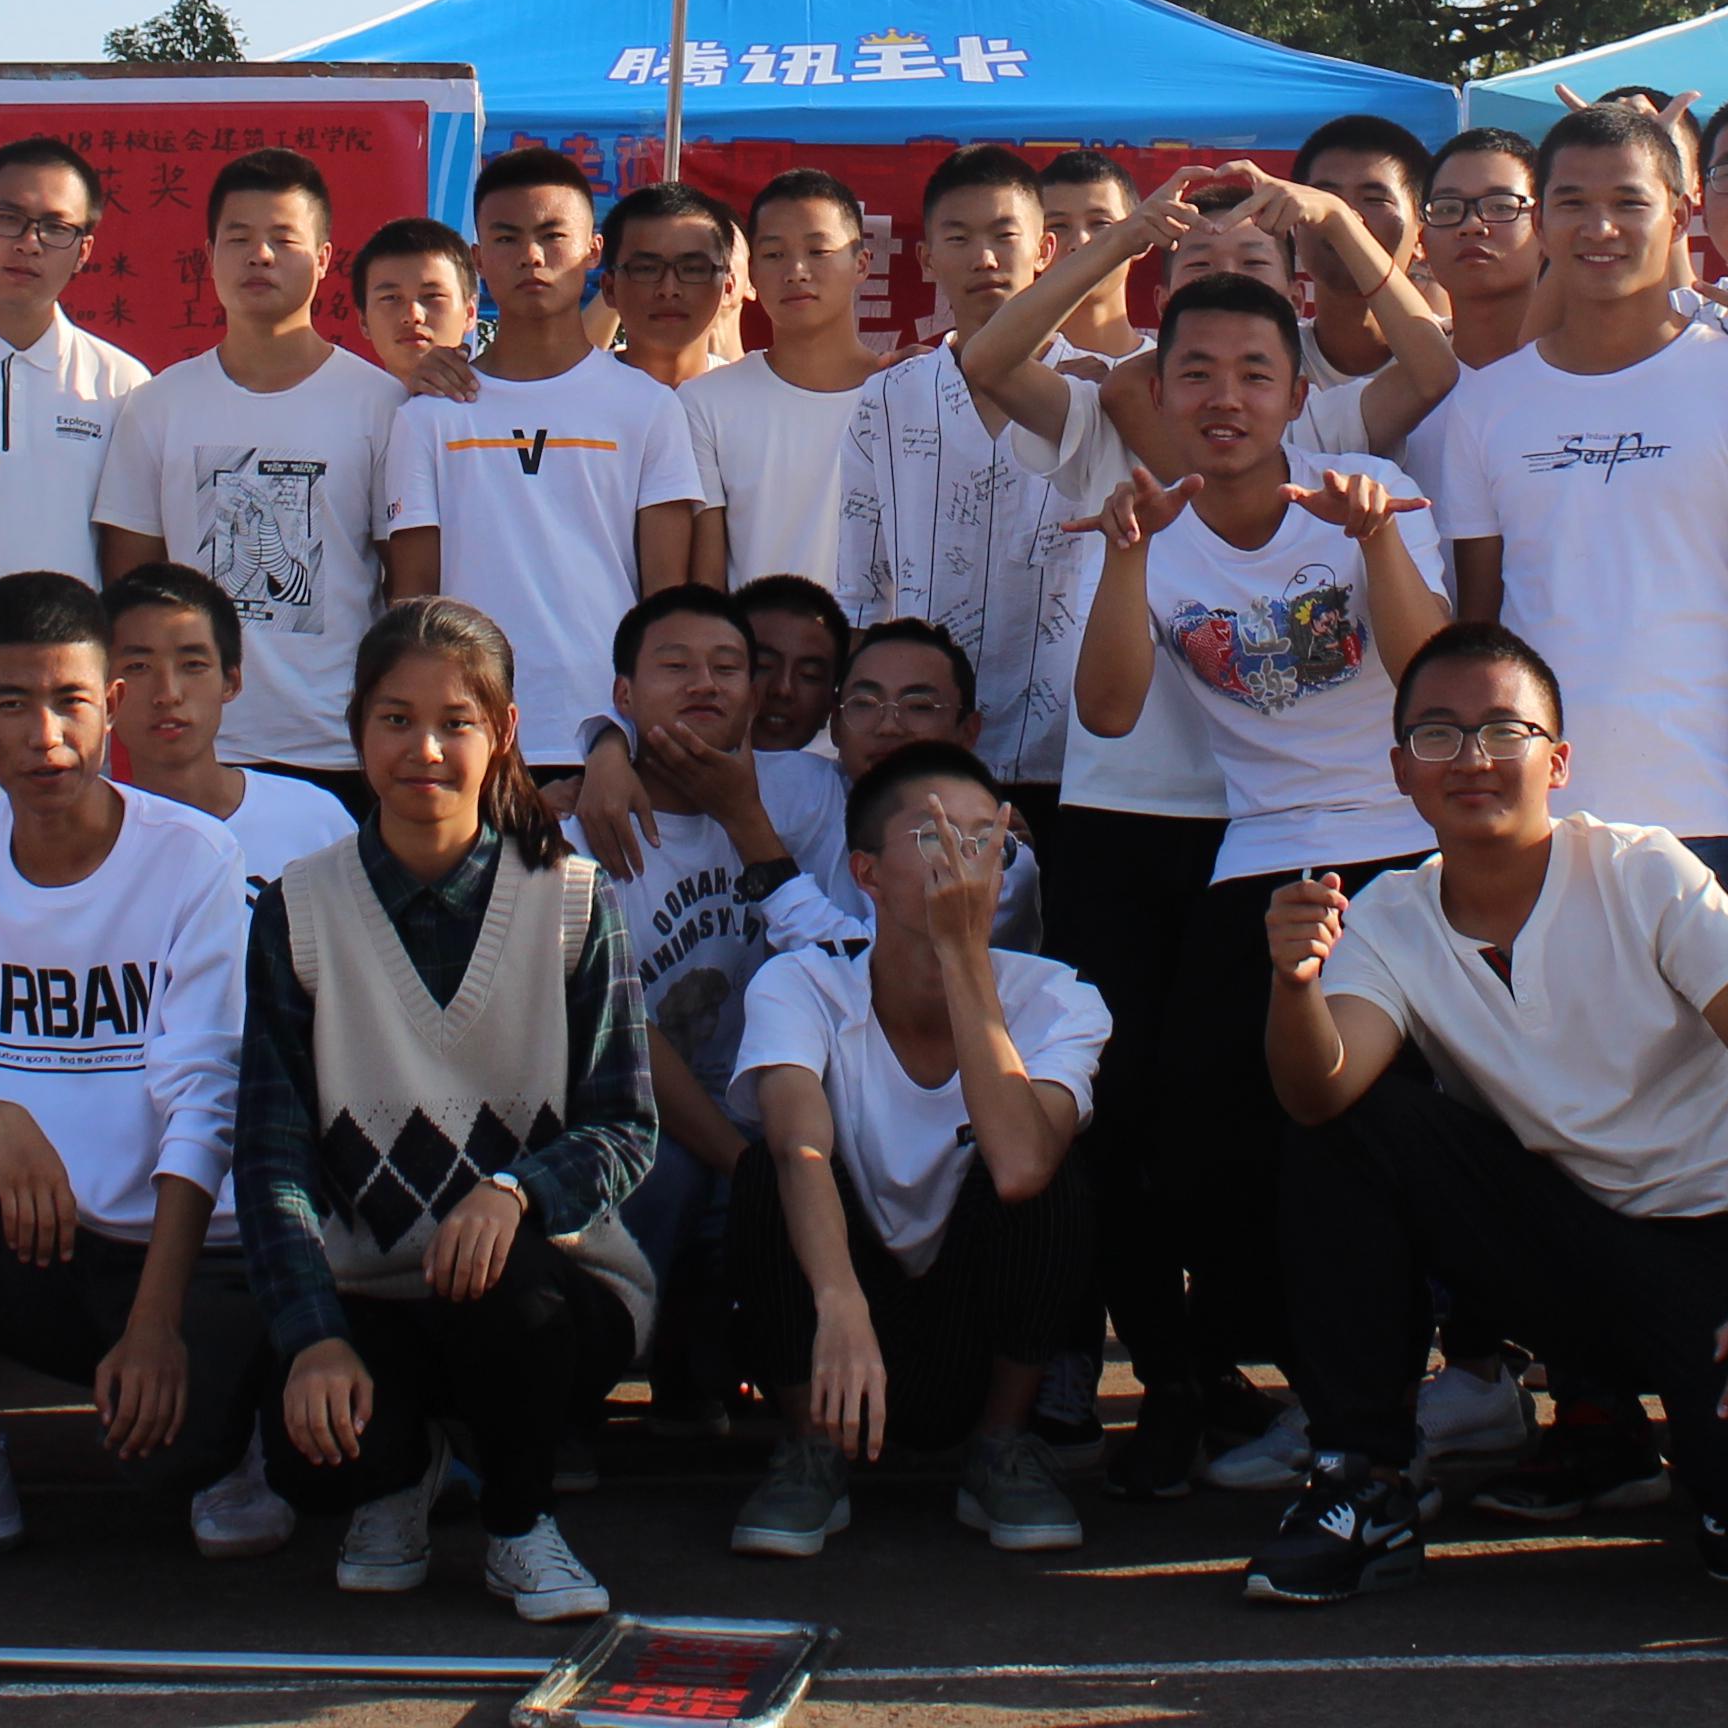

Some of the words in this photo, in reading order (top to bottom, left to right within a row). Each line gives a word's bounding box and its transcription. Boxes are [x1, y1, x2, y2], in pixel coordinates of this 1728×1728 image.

[56, 415, 102, 433] Exploring
[512, 429, 548, 475] V
[25, 1053, 52, 1065] sports
[77, 1055, 93, 1064] the
